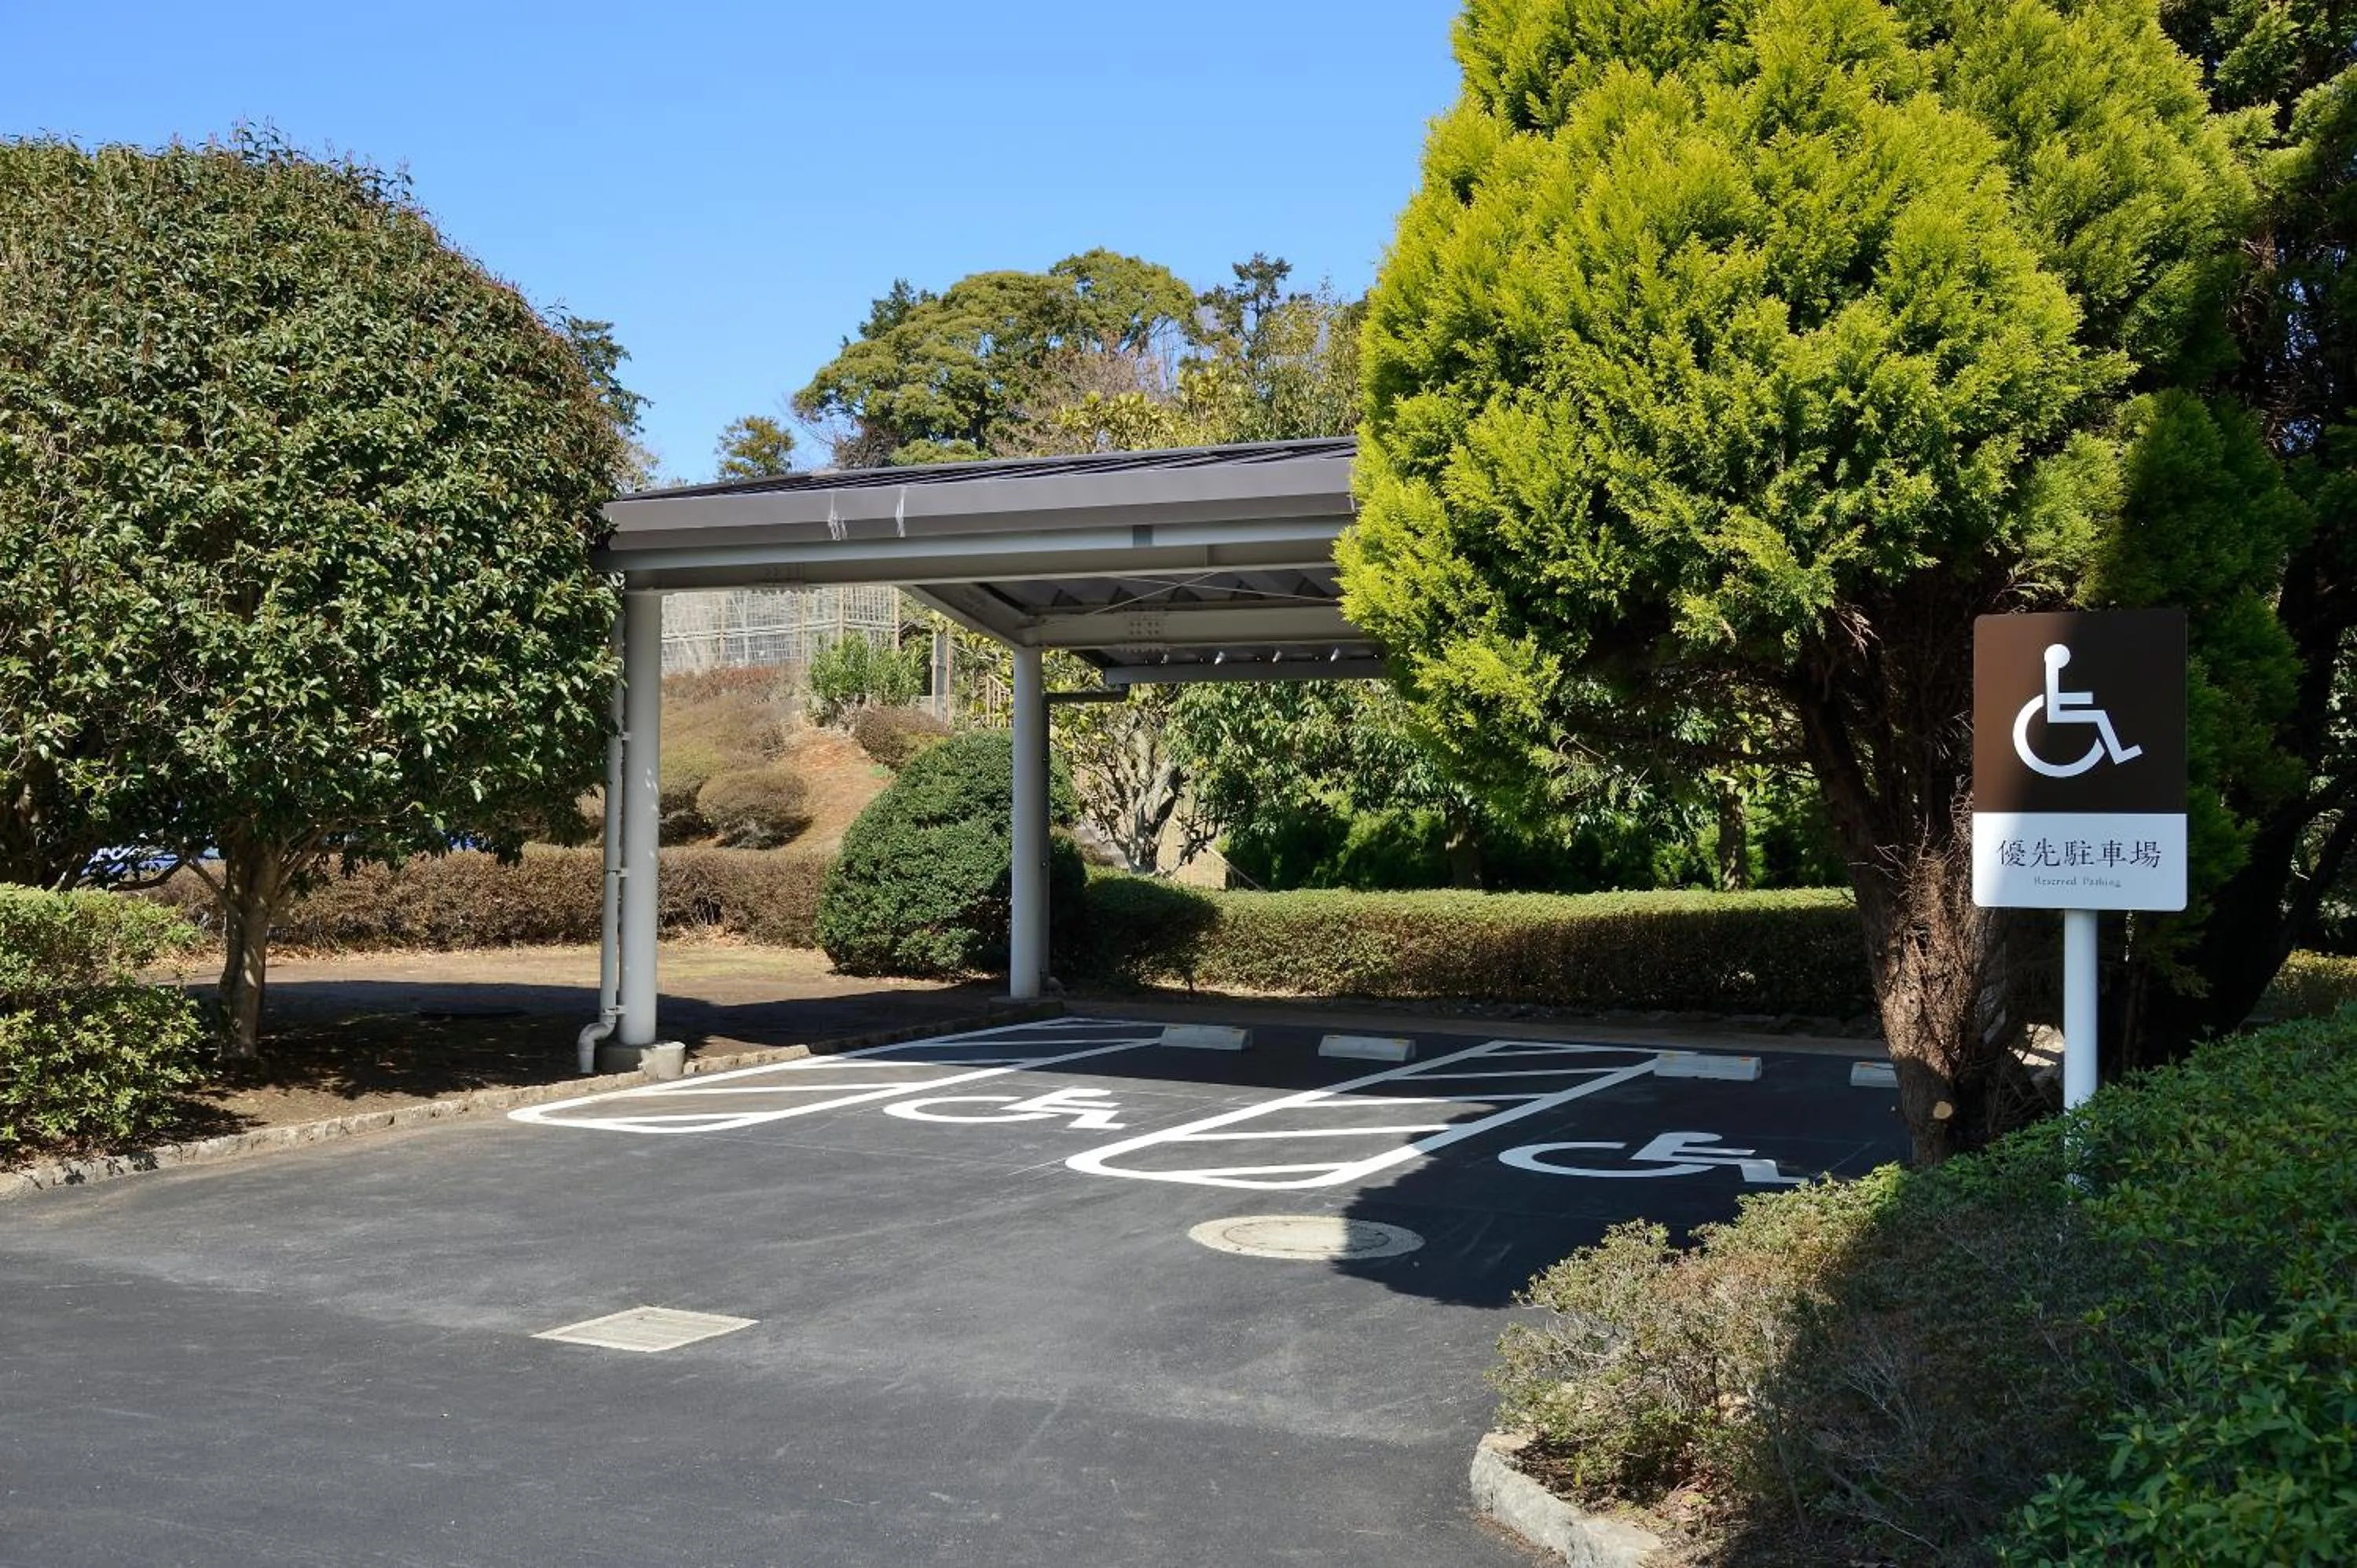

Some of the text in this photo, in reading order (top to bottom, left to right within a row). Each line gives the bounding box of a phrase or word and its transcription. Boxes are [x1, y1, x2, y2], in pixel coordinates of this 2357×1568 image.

[1996, 837, 2161, 868] 優先駐車場
[2034, 876, 2121, 888] Reserved Parking
